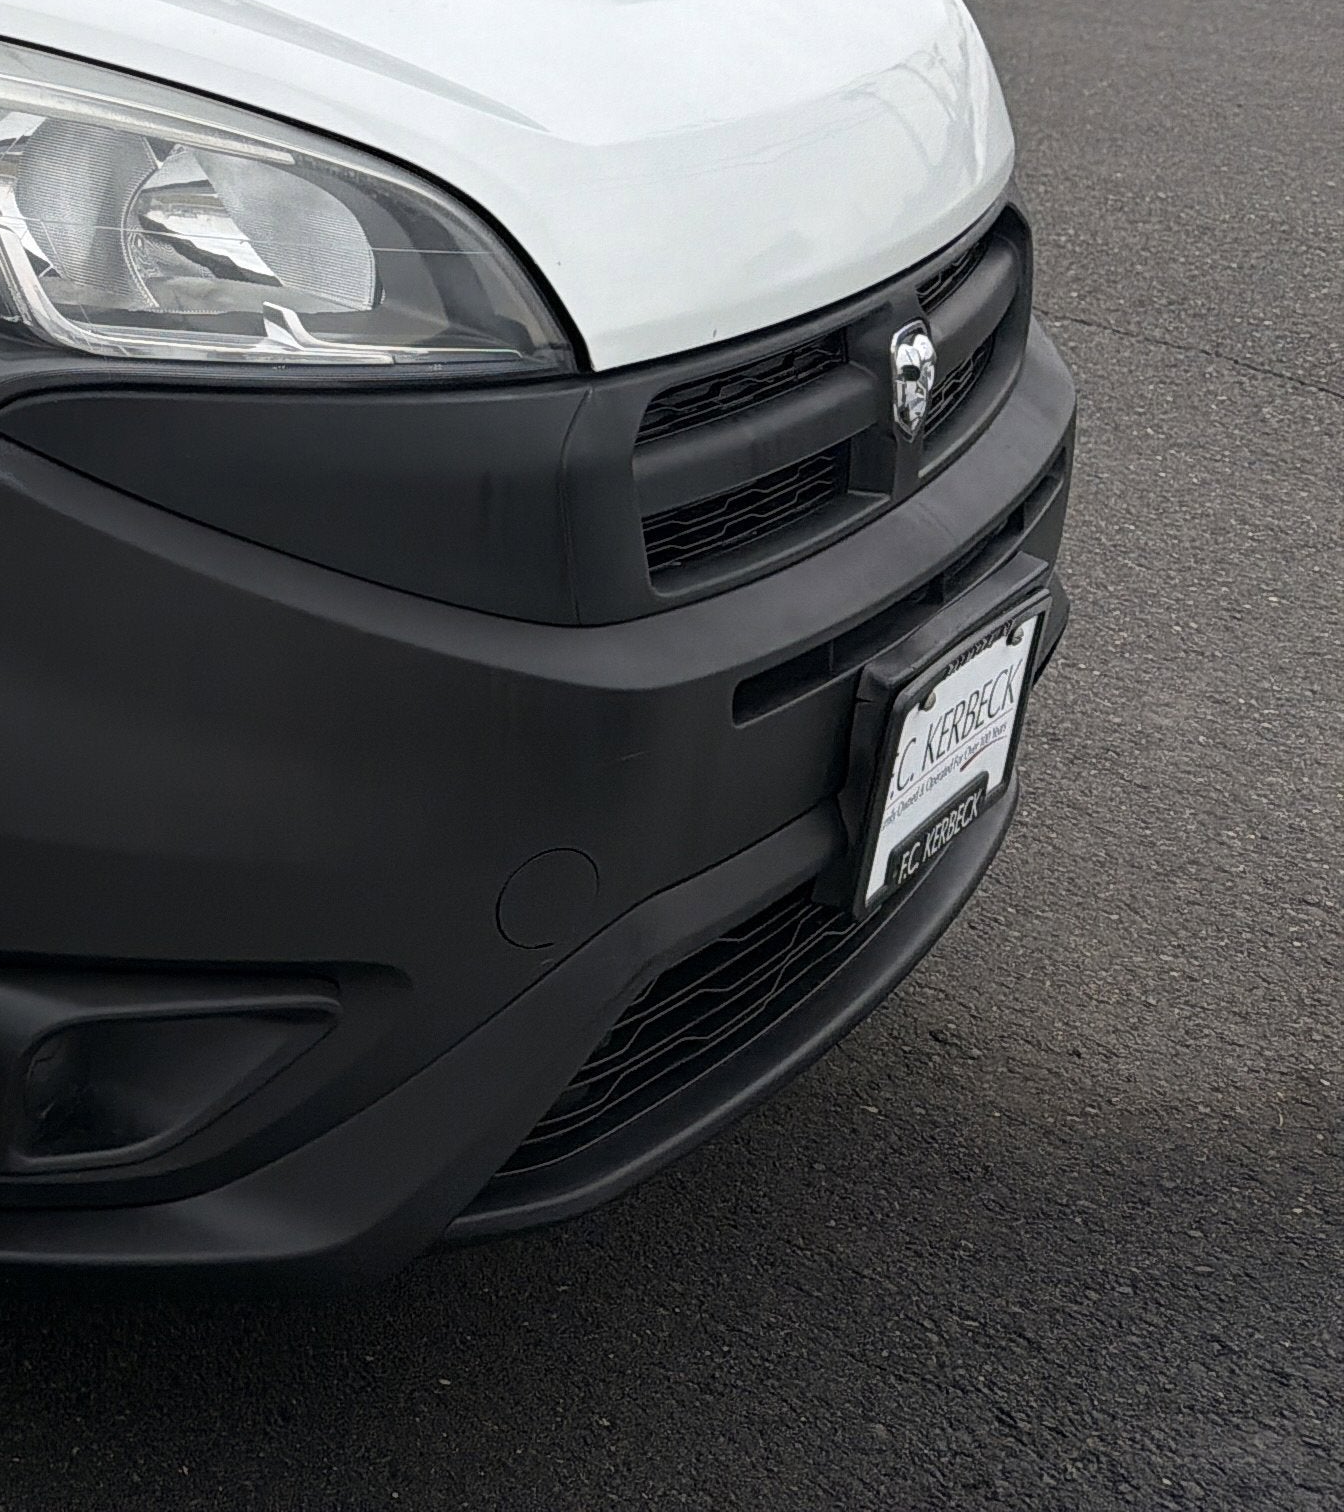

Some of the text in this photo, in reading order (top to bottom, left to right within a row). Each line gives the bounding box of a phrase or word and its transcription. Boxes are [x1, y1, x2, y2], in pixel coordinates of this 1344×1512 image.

[889, 658, 1024, 801] .C. KERBECK
[921, 787, 983, 863] KERBECK
